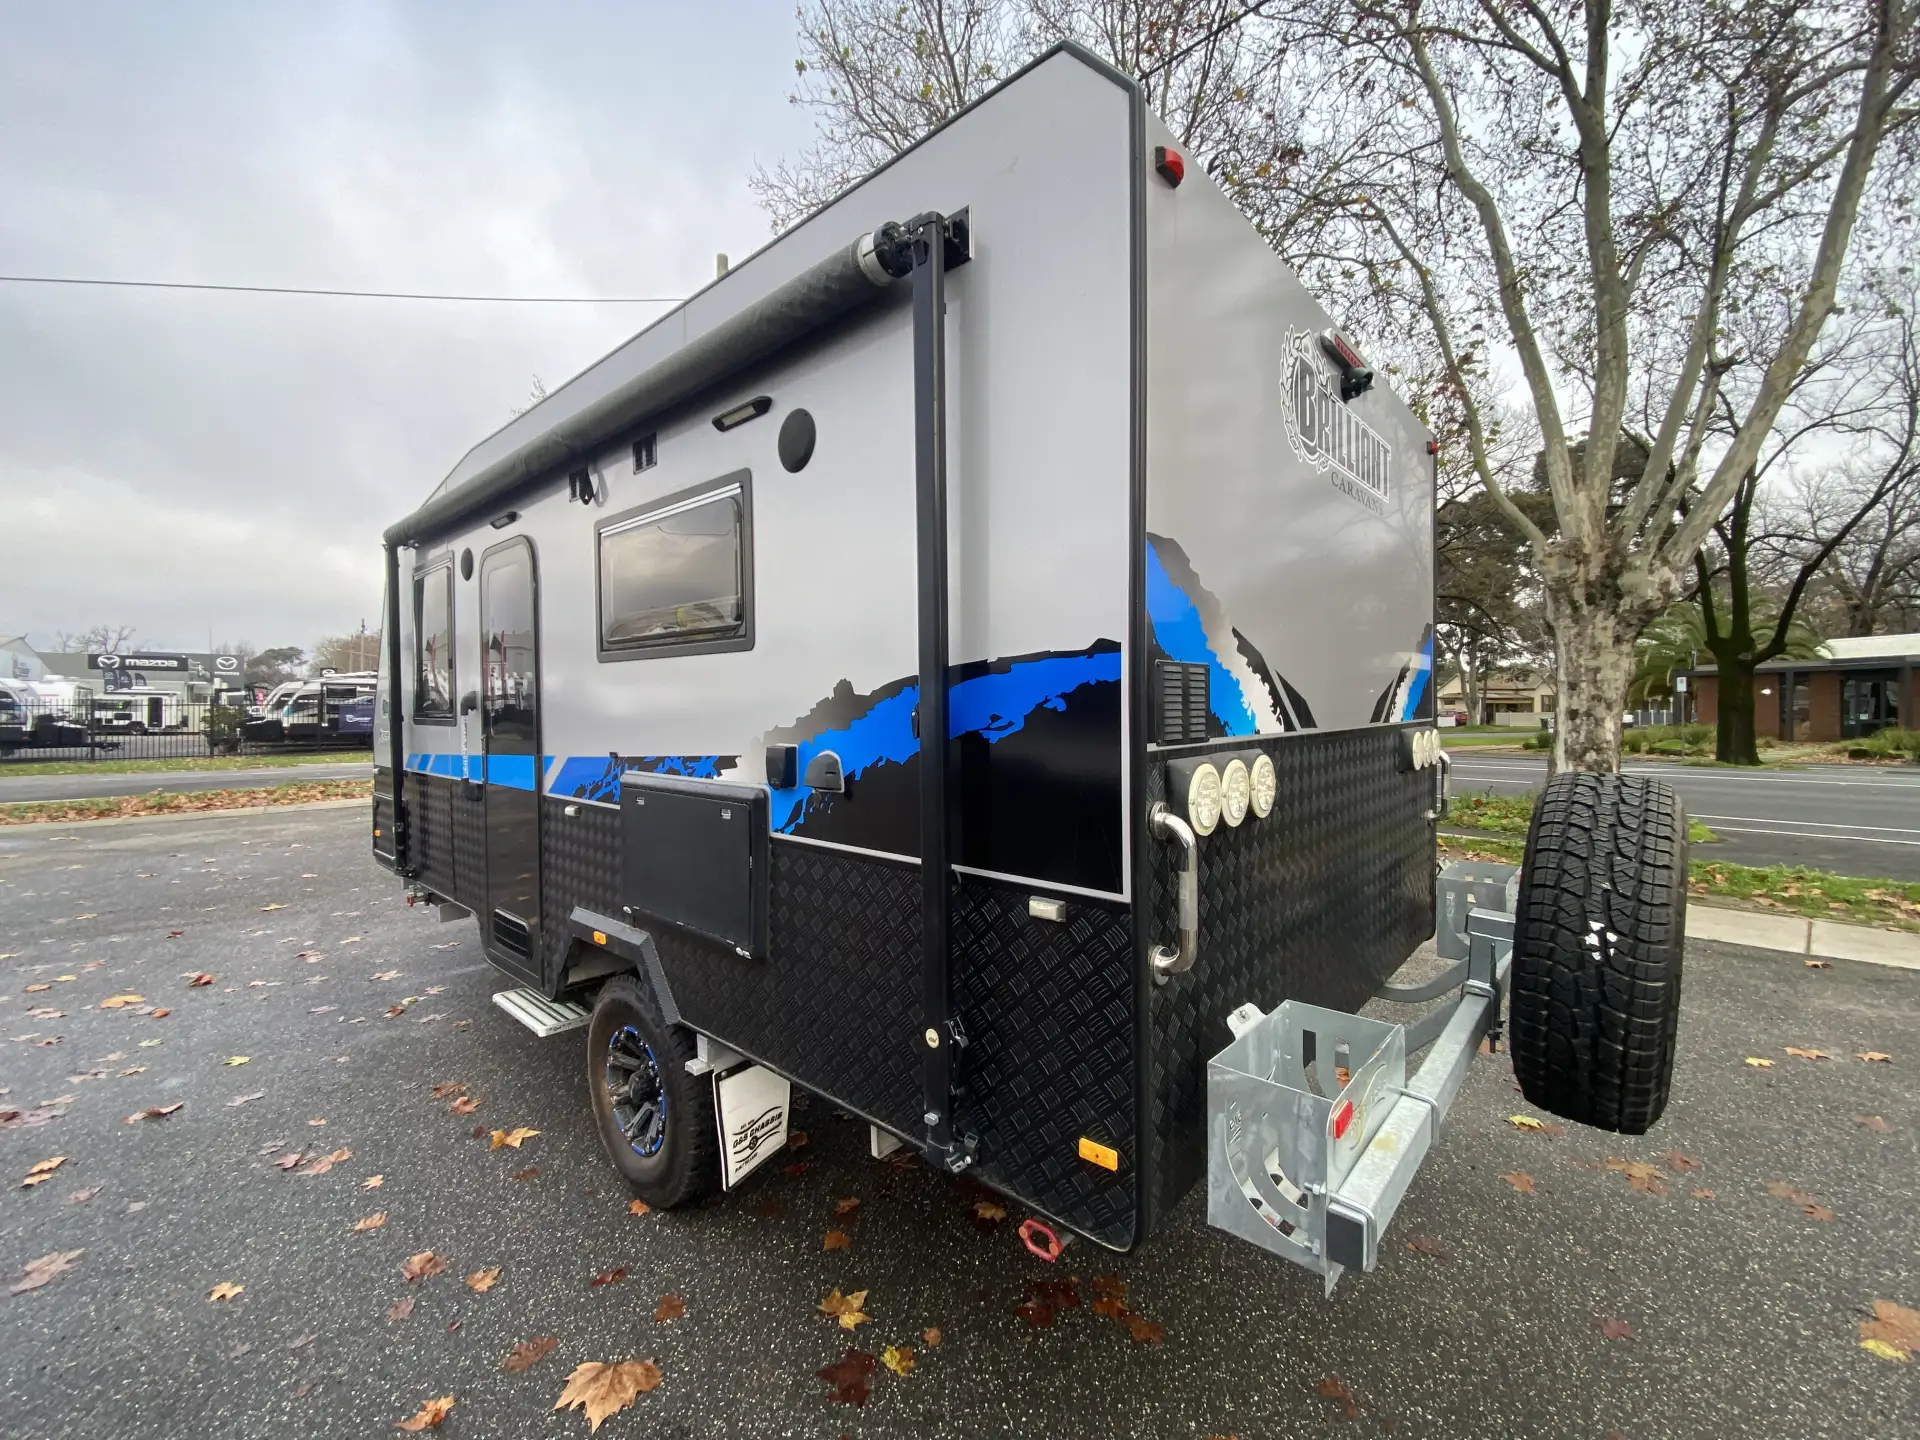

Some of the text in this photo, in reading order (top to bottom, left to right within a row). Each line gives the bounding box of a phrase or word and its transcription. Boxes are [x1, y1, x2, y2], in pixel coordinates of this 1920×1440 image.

[1299, 356, 1392, 504] BRILLIANT
[1331, 472, 1384, 516] CARAVANS
[125, 657, 178, 668] mazda
[749, 1112, 783, 1137] CHASSIS
